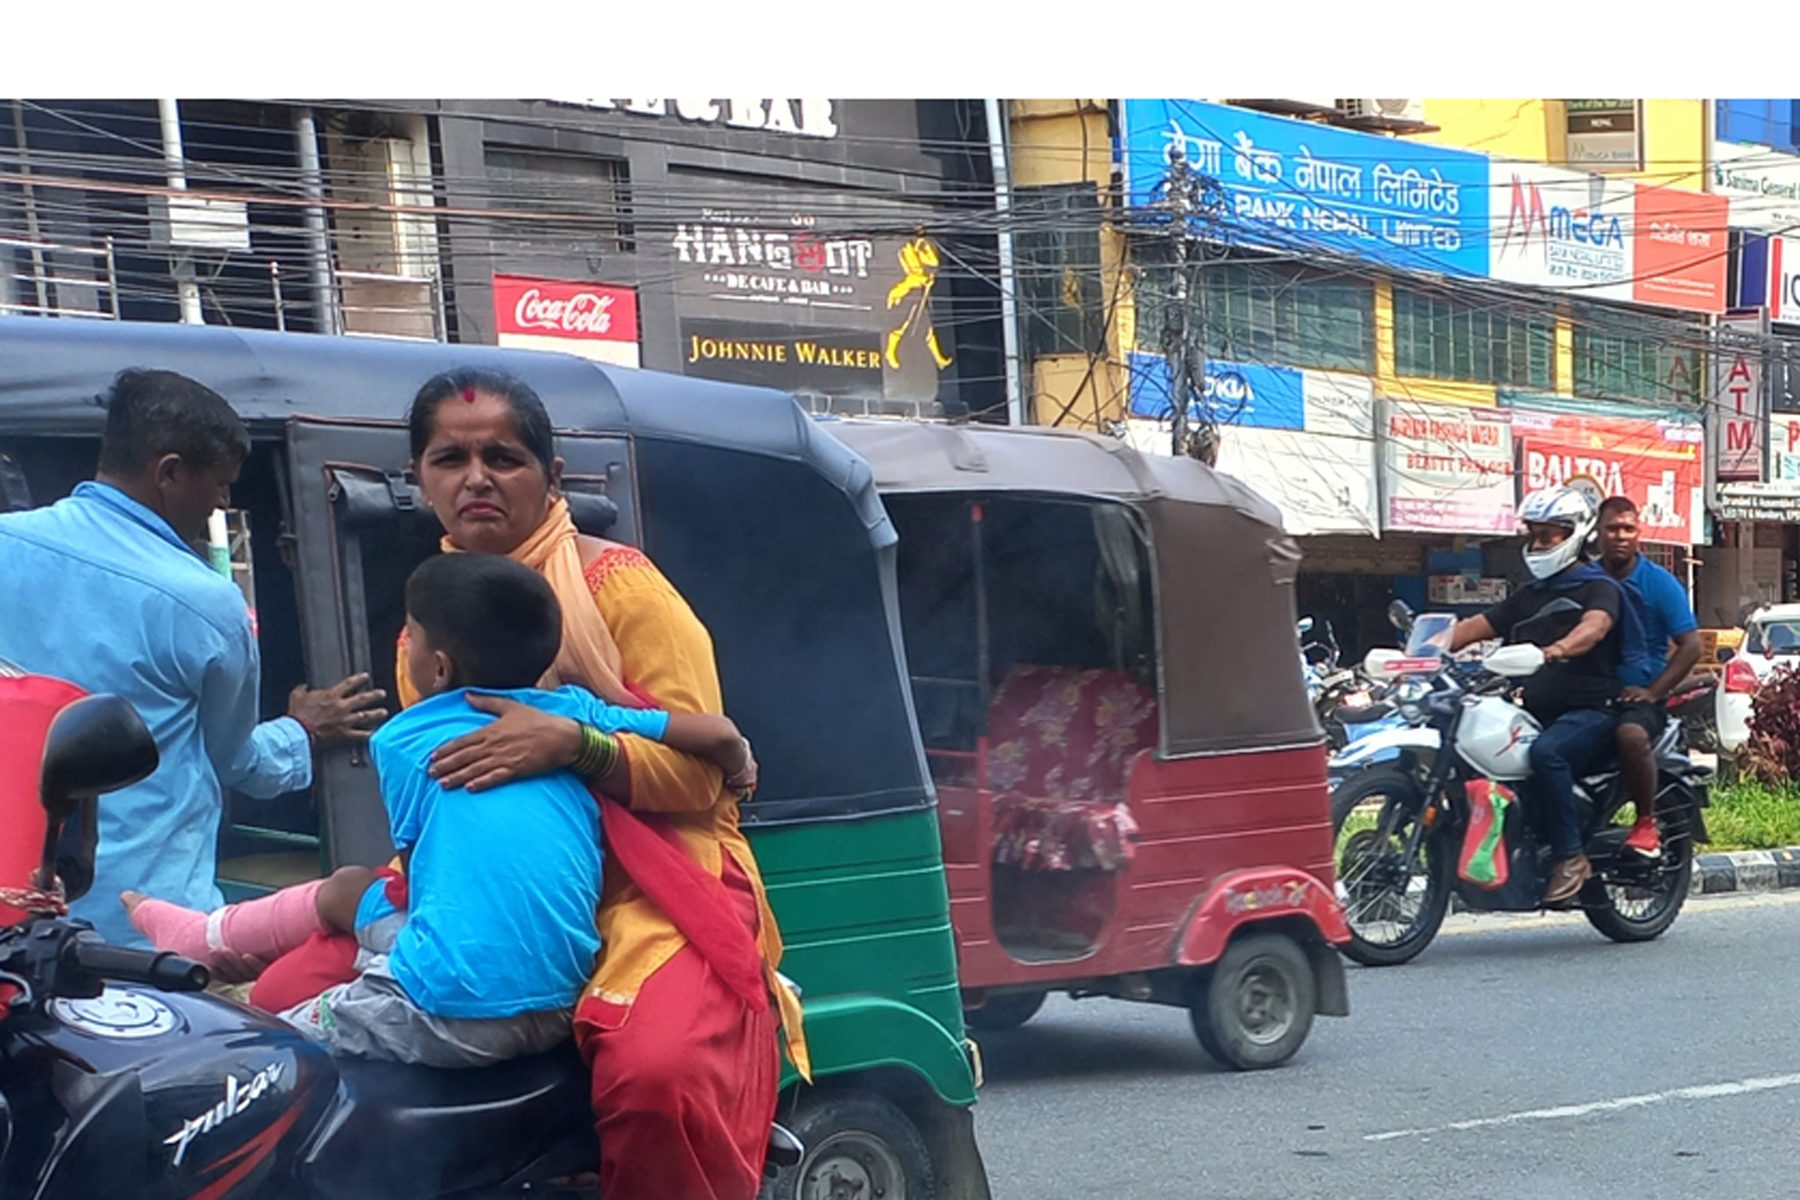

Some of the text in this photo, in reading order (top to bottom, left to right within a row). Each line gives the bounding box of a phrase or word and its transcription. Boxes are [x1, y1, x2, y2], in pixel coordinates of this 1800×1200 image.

[1232, 130, 1283, 183] बैंक
[1293, 146, 1362, 198] नेपाल
[1372, 163, 1461, 215] लिमिटेड
[1234, 191, 1297, 229] BANK
[1302, 206, 1377, 241] NEPAL
[1382, 219, 1462, 252] LIMITED
[515, 288, 616, 333] Coca-Cola
[689, 334, 882, 368] JOHNNIE WALKER
